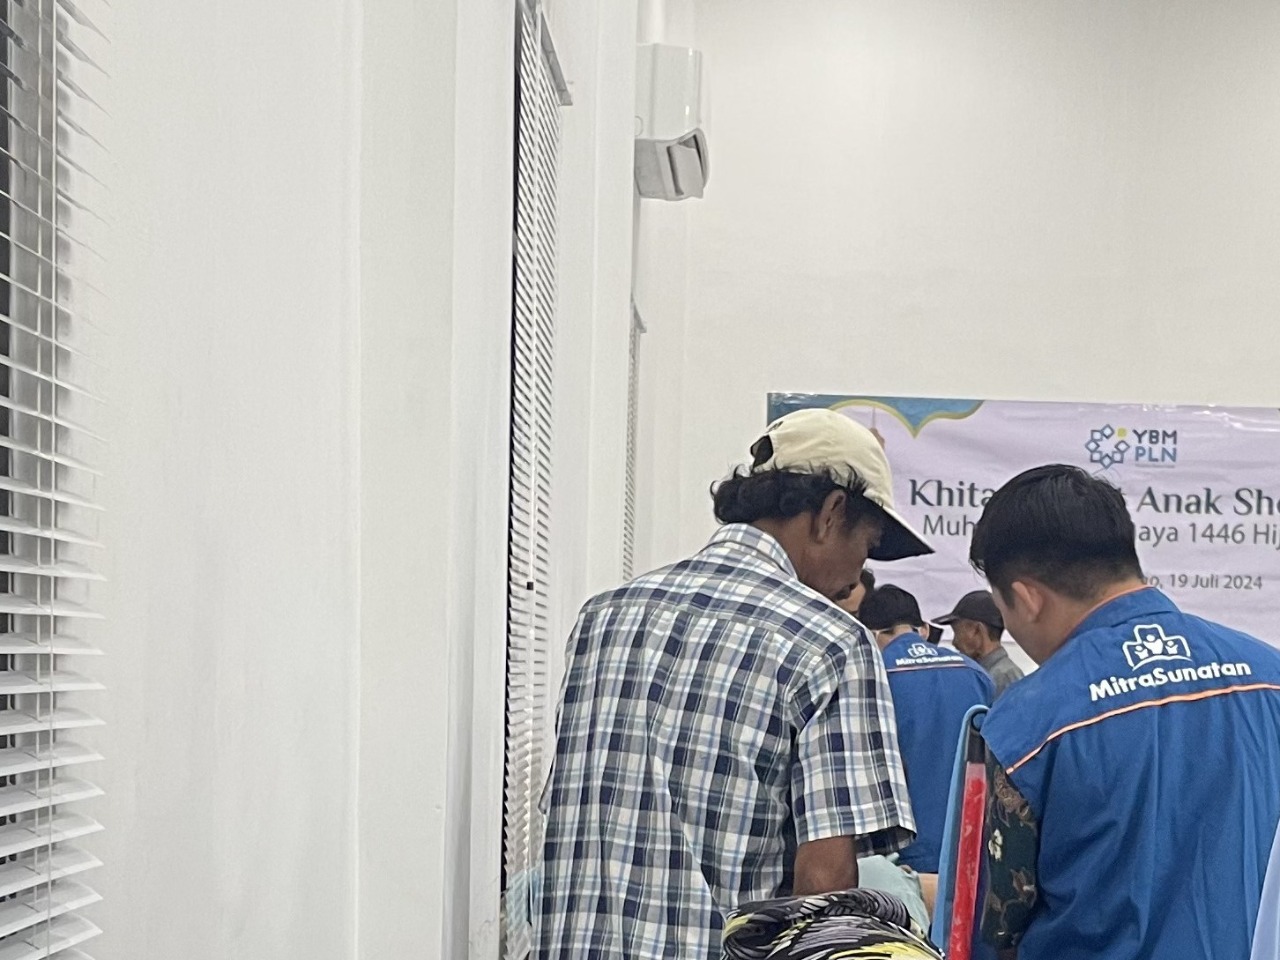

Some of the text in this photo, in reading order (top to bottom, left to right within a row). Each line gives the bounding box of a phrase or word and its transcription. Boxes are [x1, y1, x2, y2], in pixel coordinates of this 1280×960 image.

[1132, 429, 1177, 445] YBM
[1135, 446, 1177, 463] PLN
[909, 479, 996, 508] Khita
[1136, 486, 1223, 515] Anak
[923, 514, 976, 536] Muh
[1138, 525, 1178, 548] aya
[1189, 523, 1246, 545] 1446
[1170, 574, 1188, 588] 19
[1191, 574, 1218, 589] Juli
[1223, 574, 1262, 590] 2024
[1089, 662, 1252, 701] MitraSunatan
